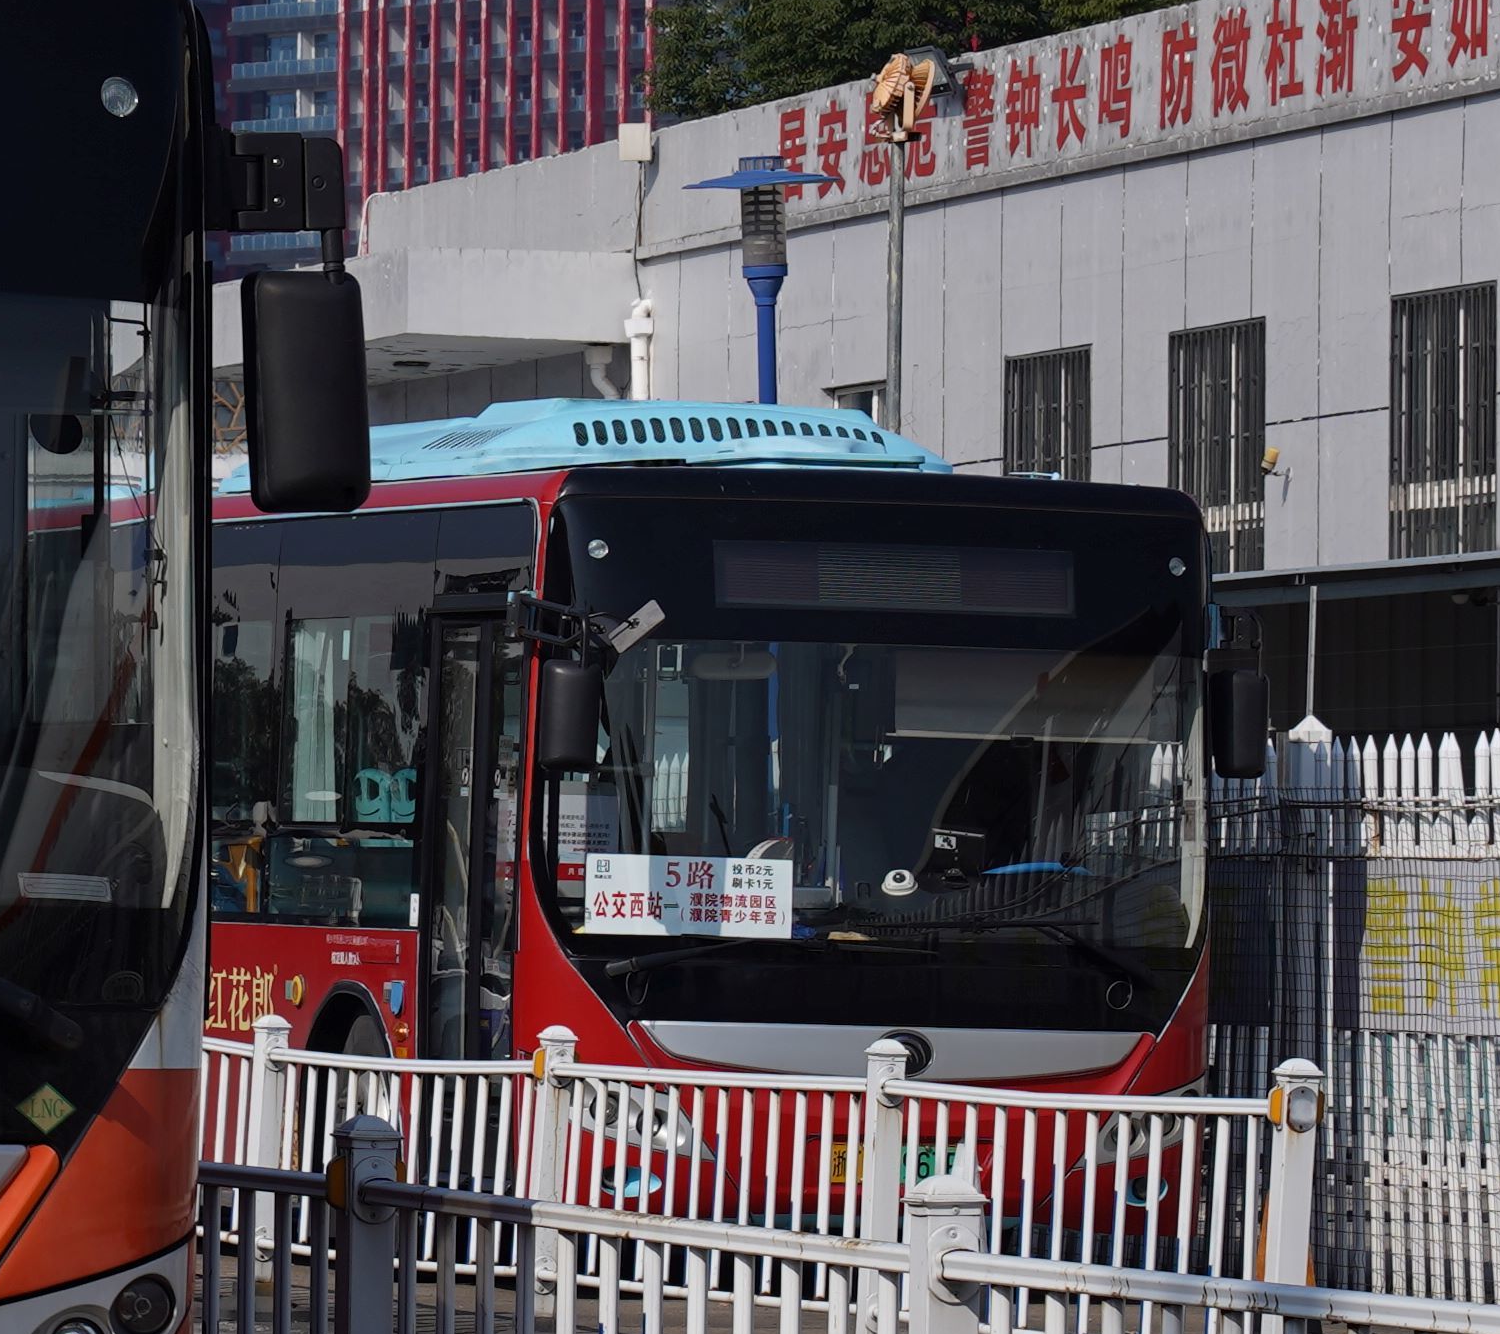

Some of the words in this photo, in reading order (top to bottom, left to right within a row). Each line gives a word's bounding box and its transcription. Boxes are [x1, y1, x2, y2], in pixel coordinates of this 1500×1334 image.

[962, 34, 1133, 171] 警钟长鸣
[664, 860, 715, 890] 5路
[731, 863, 775, 877] 投币2元
[731, 877, 775, 890] 刷卡1元
[593, 890, 663, 921] 公交西站
[204, 964, 275, 1032] 红花郎
[29, 1098, 66, 1120] LNG
